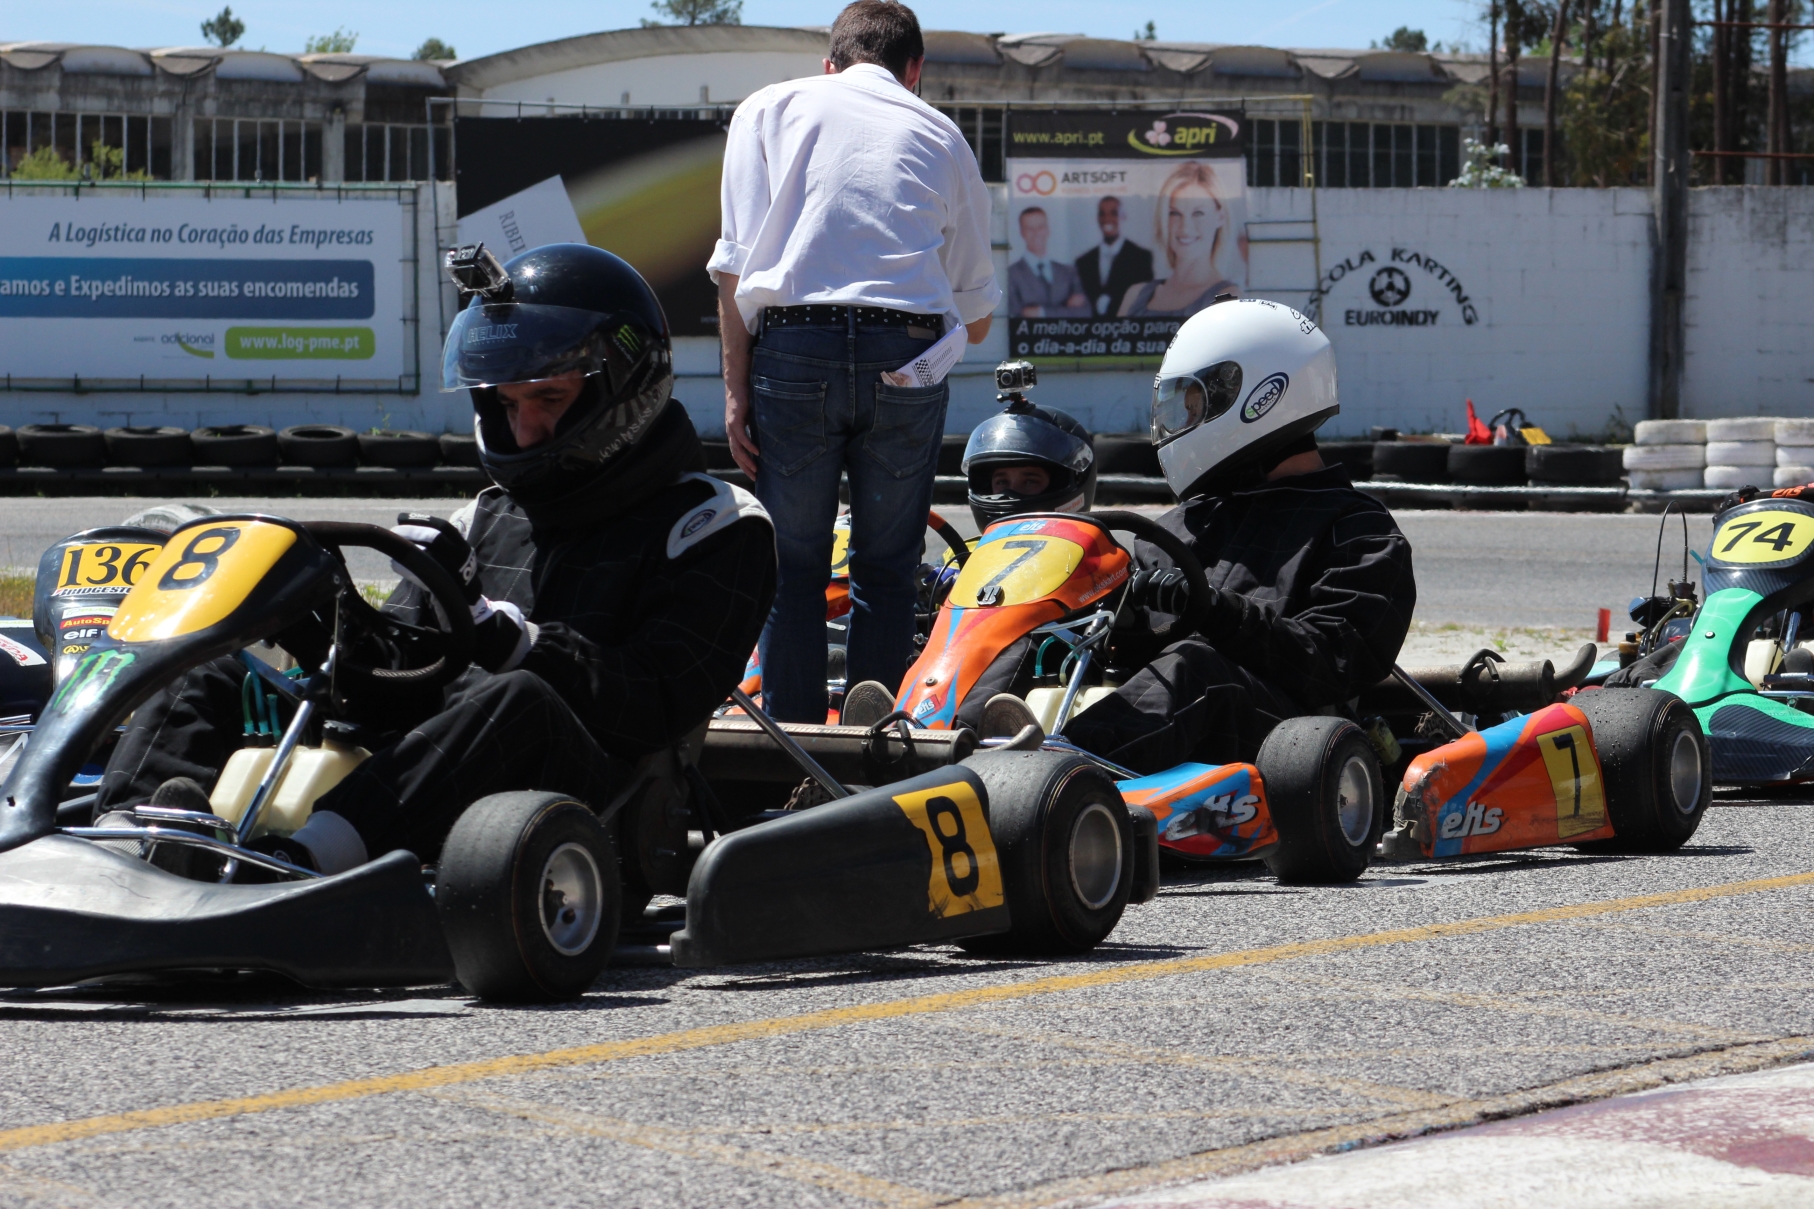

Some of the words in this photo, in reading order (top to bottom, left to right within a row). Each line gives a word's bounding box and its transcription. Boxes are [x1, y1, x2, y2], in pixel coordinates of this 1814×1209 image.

[1013, 131, 1105, 147] www.apri.pt
[1174, 122, 1217, 149] apri
[1061, 171, 1128, 184] ARTSOFT
[48, 222, 62, 243] A
[65, 222, 146, 247] Logística
[150, 226, 172, 243] no
[177, 222, 249, 249] Coração
[253, 223, 284, 245] das
[288, 225, 374, 250] Empresas
[54, 280, 66, 296] e
[70, 275, 171, 302] Expedimos
[174, 280, 195, 298] as
[198, 280, 239, 298] suas
[243, 277, 359, 299] encomendas
[1391, 247, 1479, 326] KARTING
[1016, 320, 1030, 336] A
[1033, 320, 1089, 336] melhor
[1092, 319, 1141, 340] opção
[1143, 322, 1181, 338] para
[1344, 309, 1440, 326] EUROINDY
[239, 333, 360, 352] www.log-pme.pt
[468, 323, 519, 344] HELIX
[1018, 342, 1030, 354] o
[1033, 339, 1107, 354] dia-a-dia
[1110, 339, 1132, 354] da
[1136, 341, 1167, 354] sua
[1245, 381, 1281, 417] speed
[1720, 521, 1796, 553] 74
[60, 546, 156, 588] 136
[157, 527, 242, 591] 8
[984, 540, 1049, 588] 7
[63, 628, 98, 640] elf
[1552, 733, 1580, 818] 7
[925, 795, 980, 898] 8
